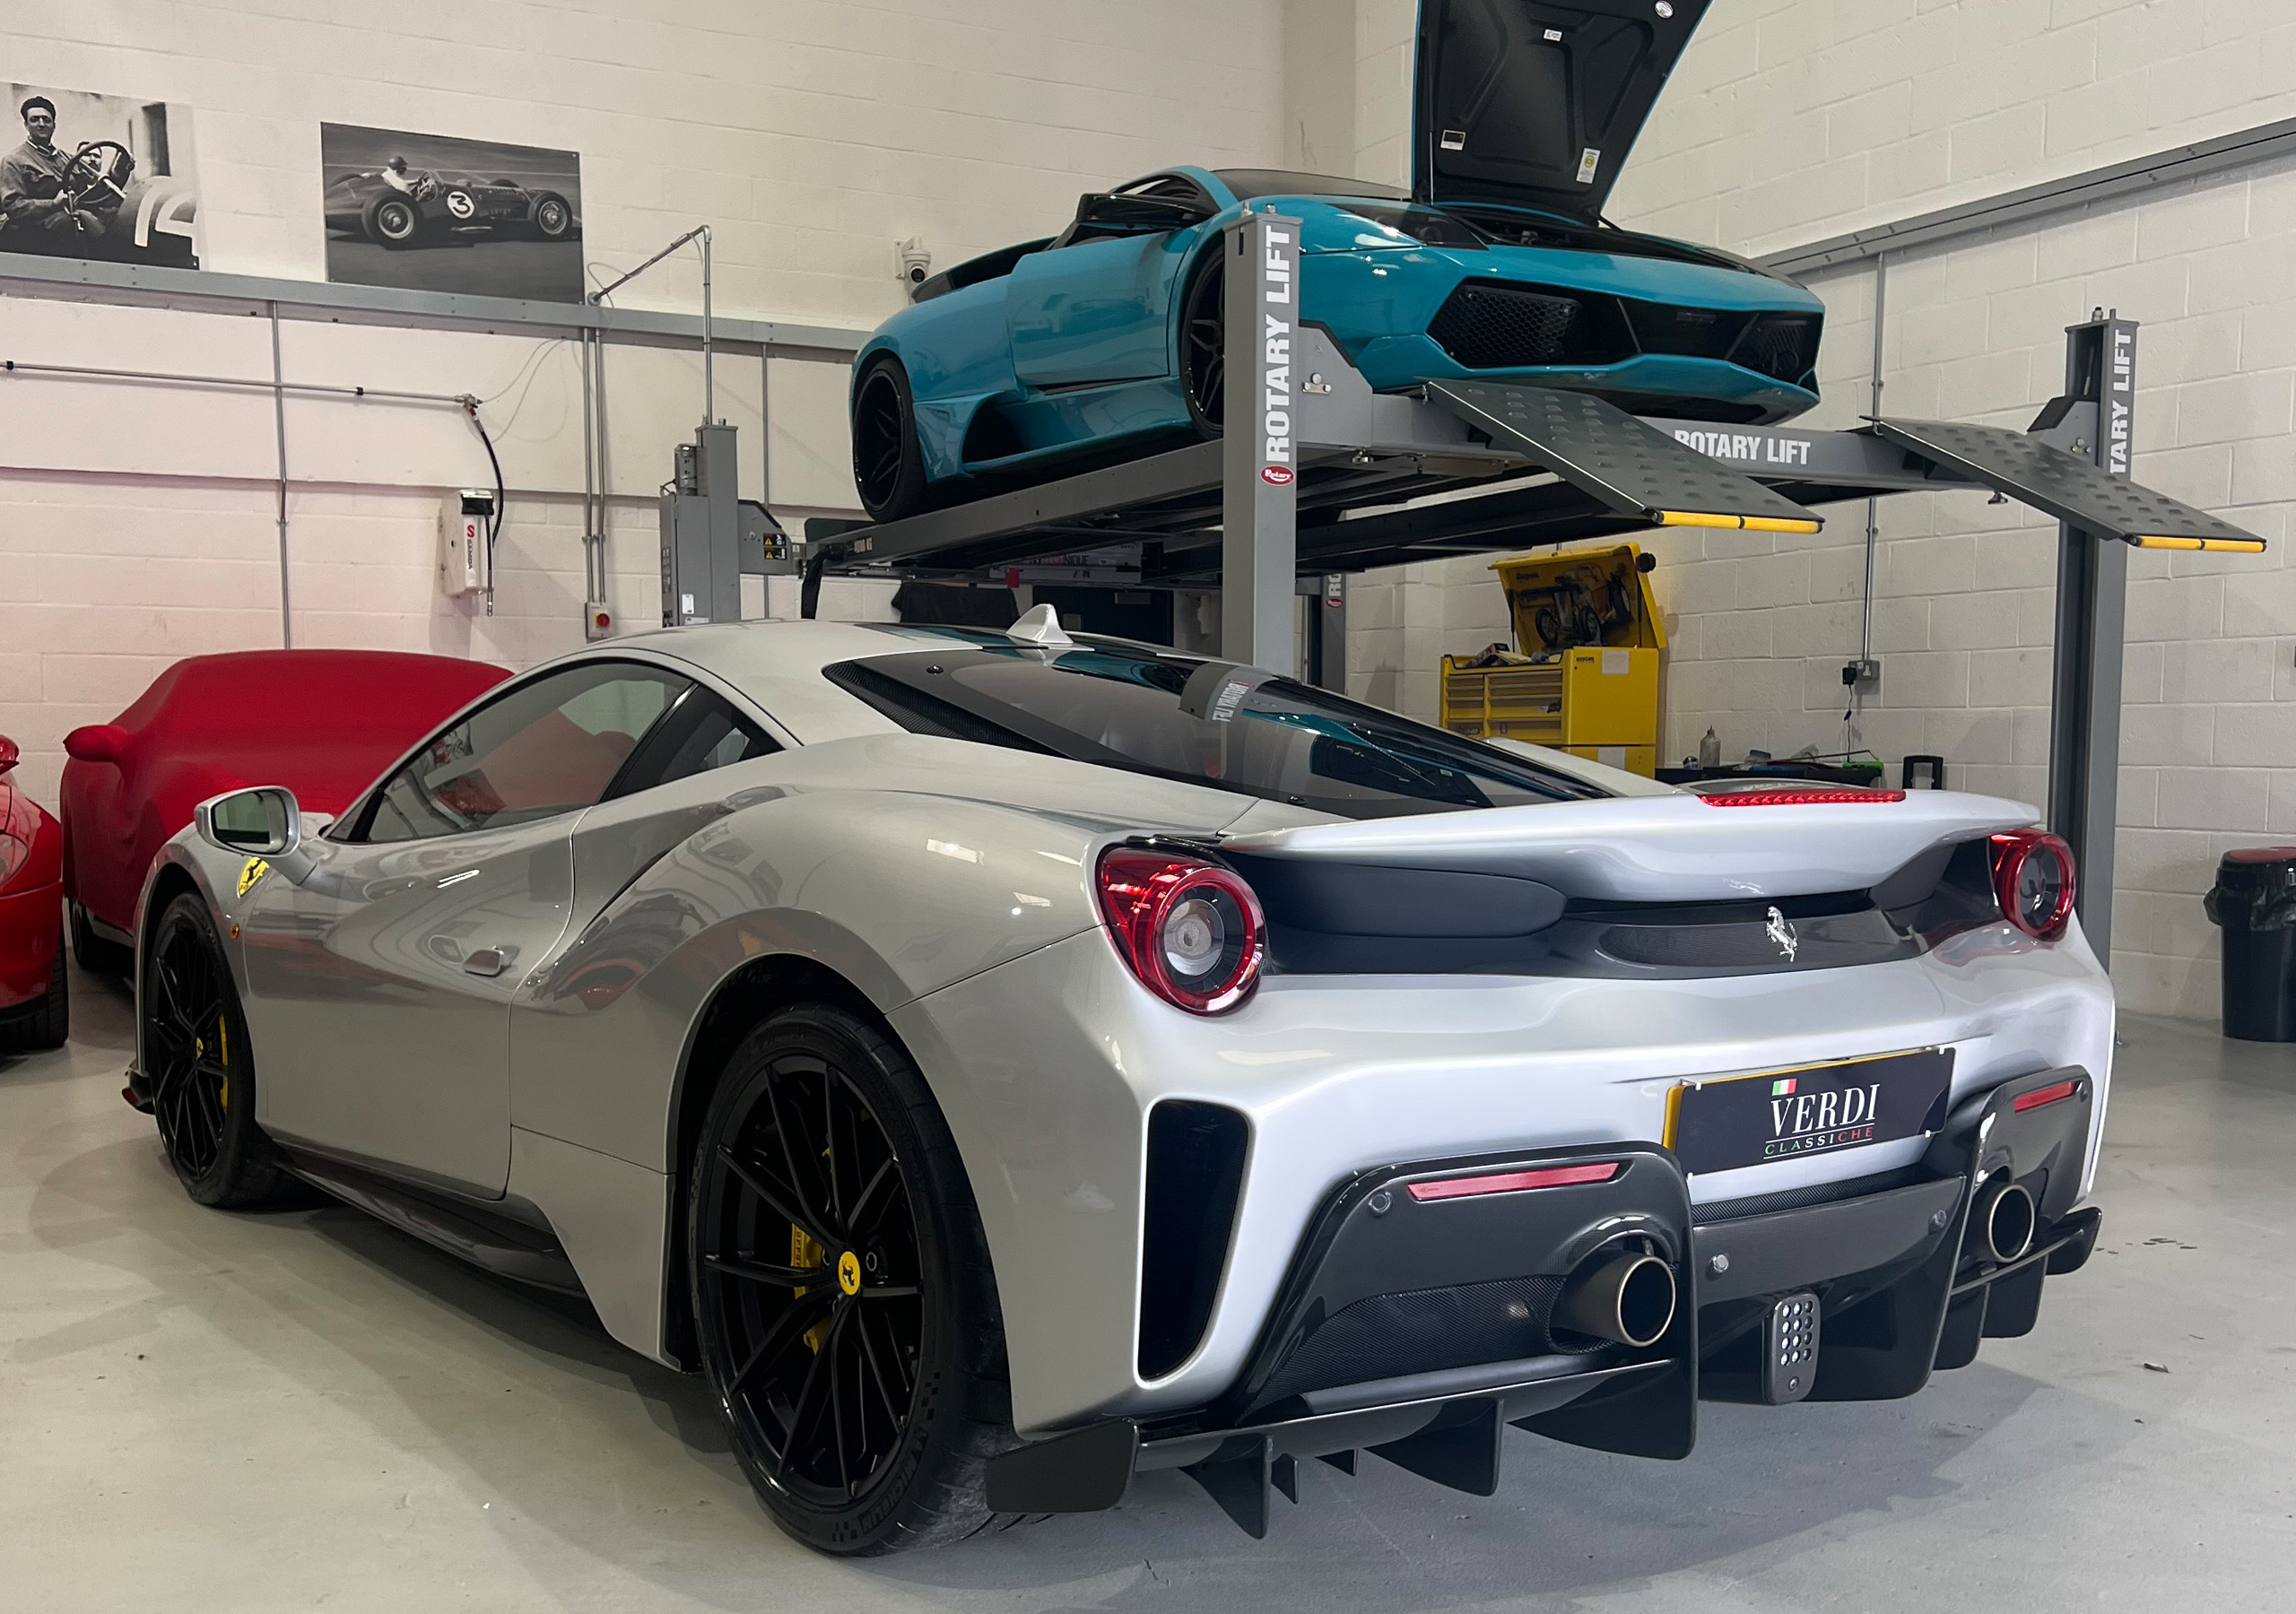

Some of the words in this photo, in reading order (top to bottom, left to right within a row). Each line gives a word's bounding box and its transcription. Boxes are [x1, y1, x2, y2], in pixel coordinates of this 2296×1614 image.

[450, 194, 471, 215] 3
[1265, 224, 1290, 304] LIFT
[1265, 314, 1290, 463] ROTARY
[2113, 329, 2131, 392] LIFT
[1674, 430, 1762, 461] ROTARY
[1766, 438, 1812, 465] LIFT
[2109, 400, 2129, 473] TARY
[1770, 1083, 1881, 1137] VERDI
[1764, 1126, 1874, 1155] CLASSICHE
